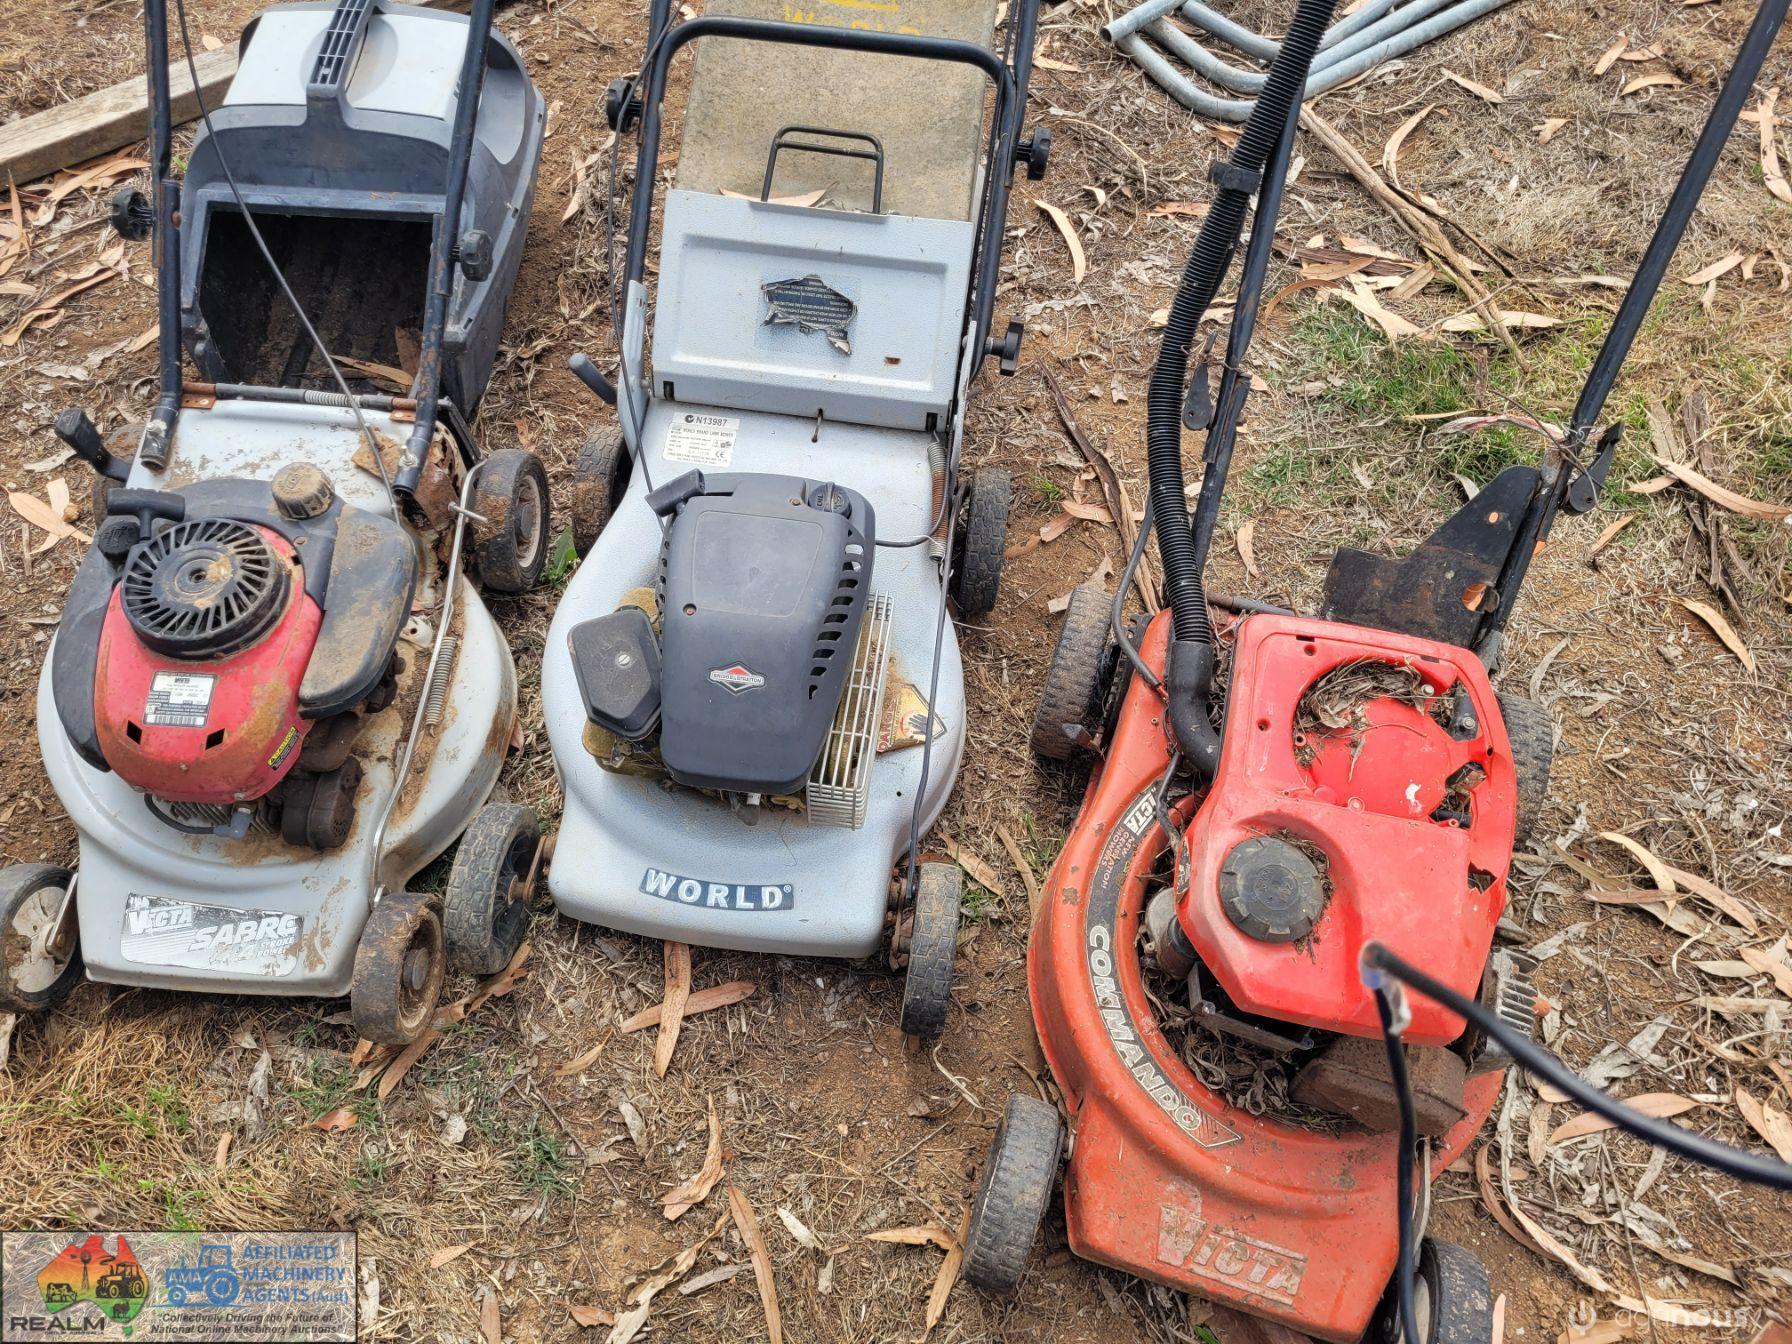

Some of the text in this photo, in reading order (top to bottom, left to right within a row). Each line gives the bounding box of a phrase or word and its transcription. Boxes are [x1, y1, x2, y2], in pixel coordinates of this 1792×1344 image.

[696, 416, 728, 427] N13987
[1121, 835, 1135, 858] NEW
[646, 869, 782, 909] WORLD
[1089, 925, 1202, 1130] COMMANDO
[1157, 1207, 1306, 1295] VICTA
